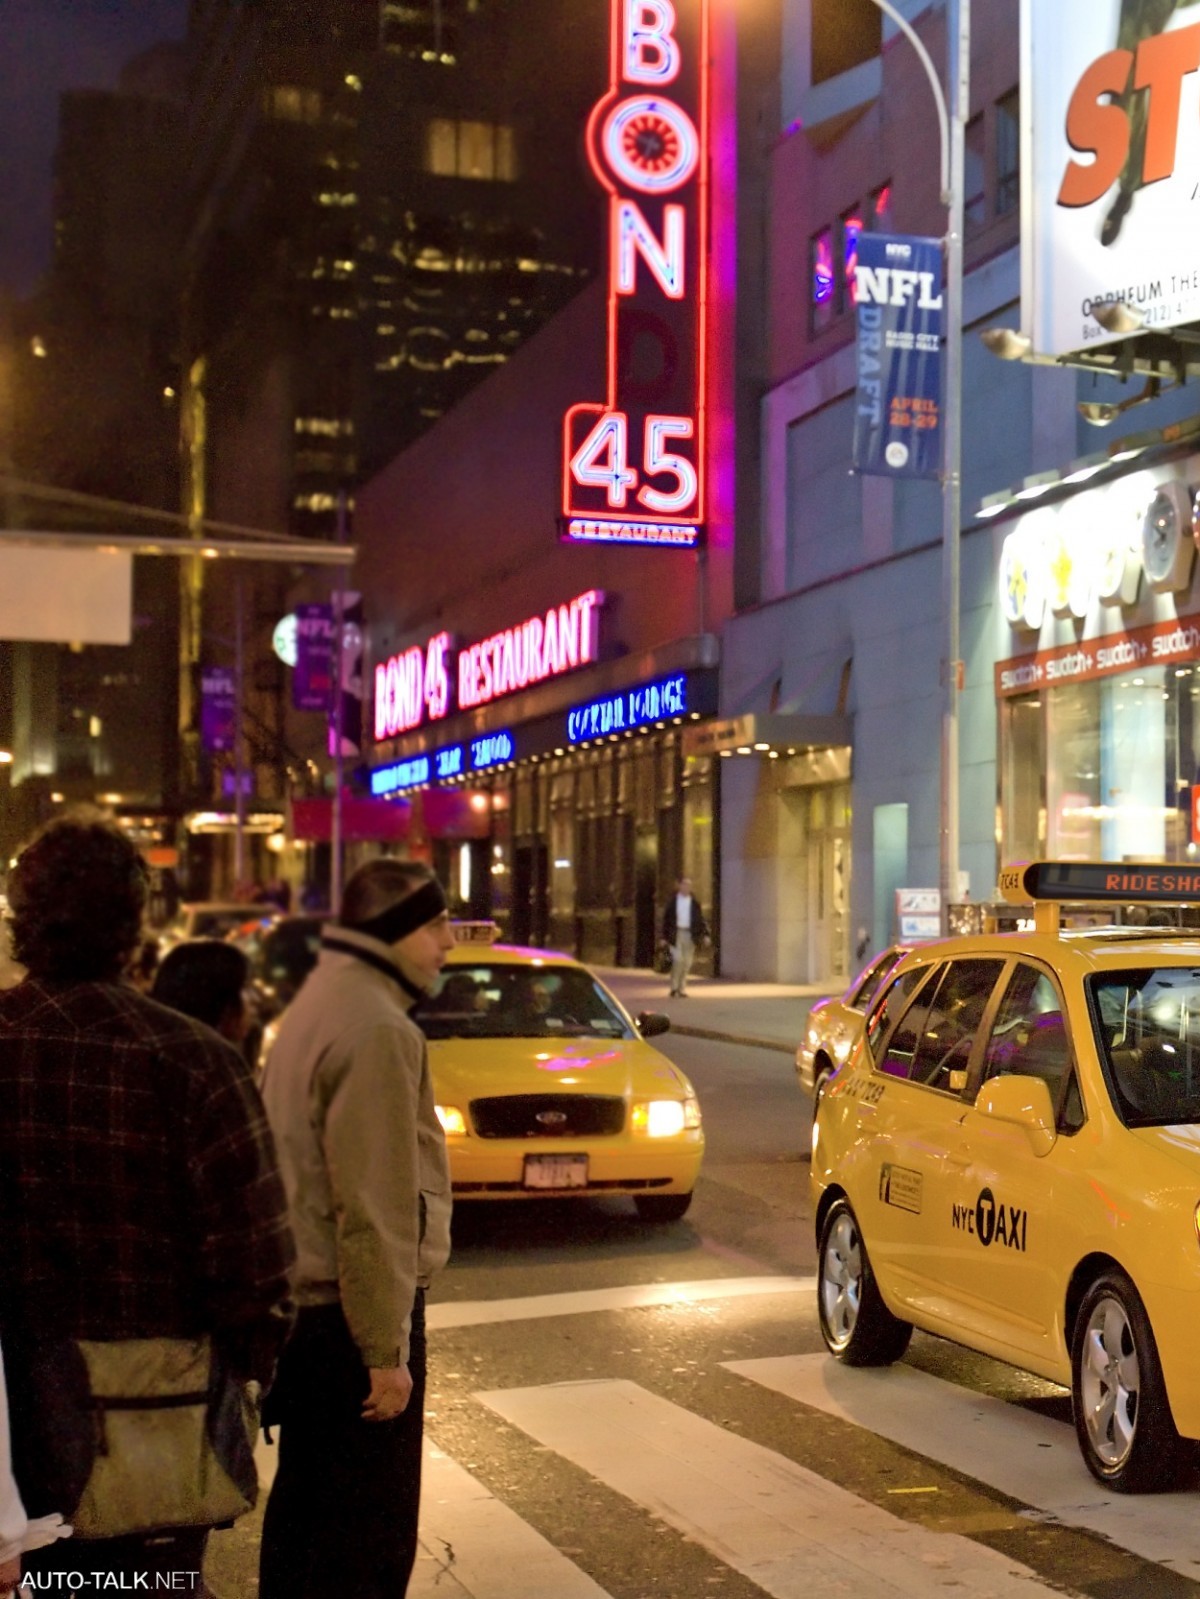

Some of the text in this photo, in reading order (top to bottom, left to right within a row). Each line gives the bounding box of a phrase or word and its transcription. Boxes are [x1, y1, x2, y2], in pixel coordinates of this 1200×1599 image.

[885, 243, 912, 257] NYC
[853, 265, 943, 310] NFL
[858, 304, 883, 425] DRAFT
[890, 397, 938, 413] APRIL
[569, 411, 698, 513] 45
[374, 588, 598, 742] BOND 45 RESTAURANT
[951, 1202, 975, 1234] NYC
[976, 1187, 1027, 1252] TAXI
